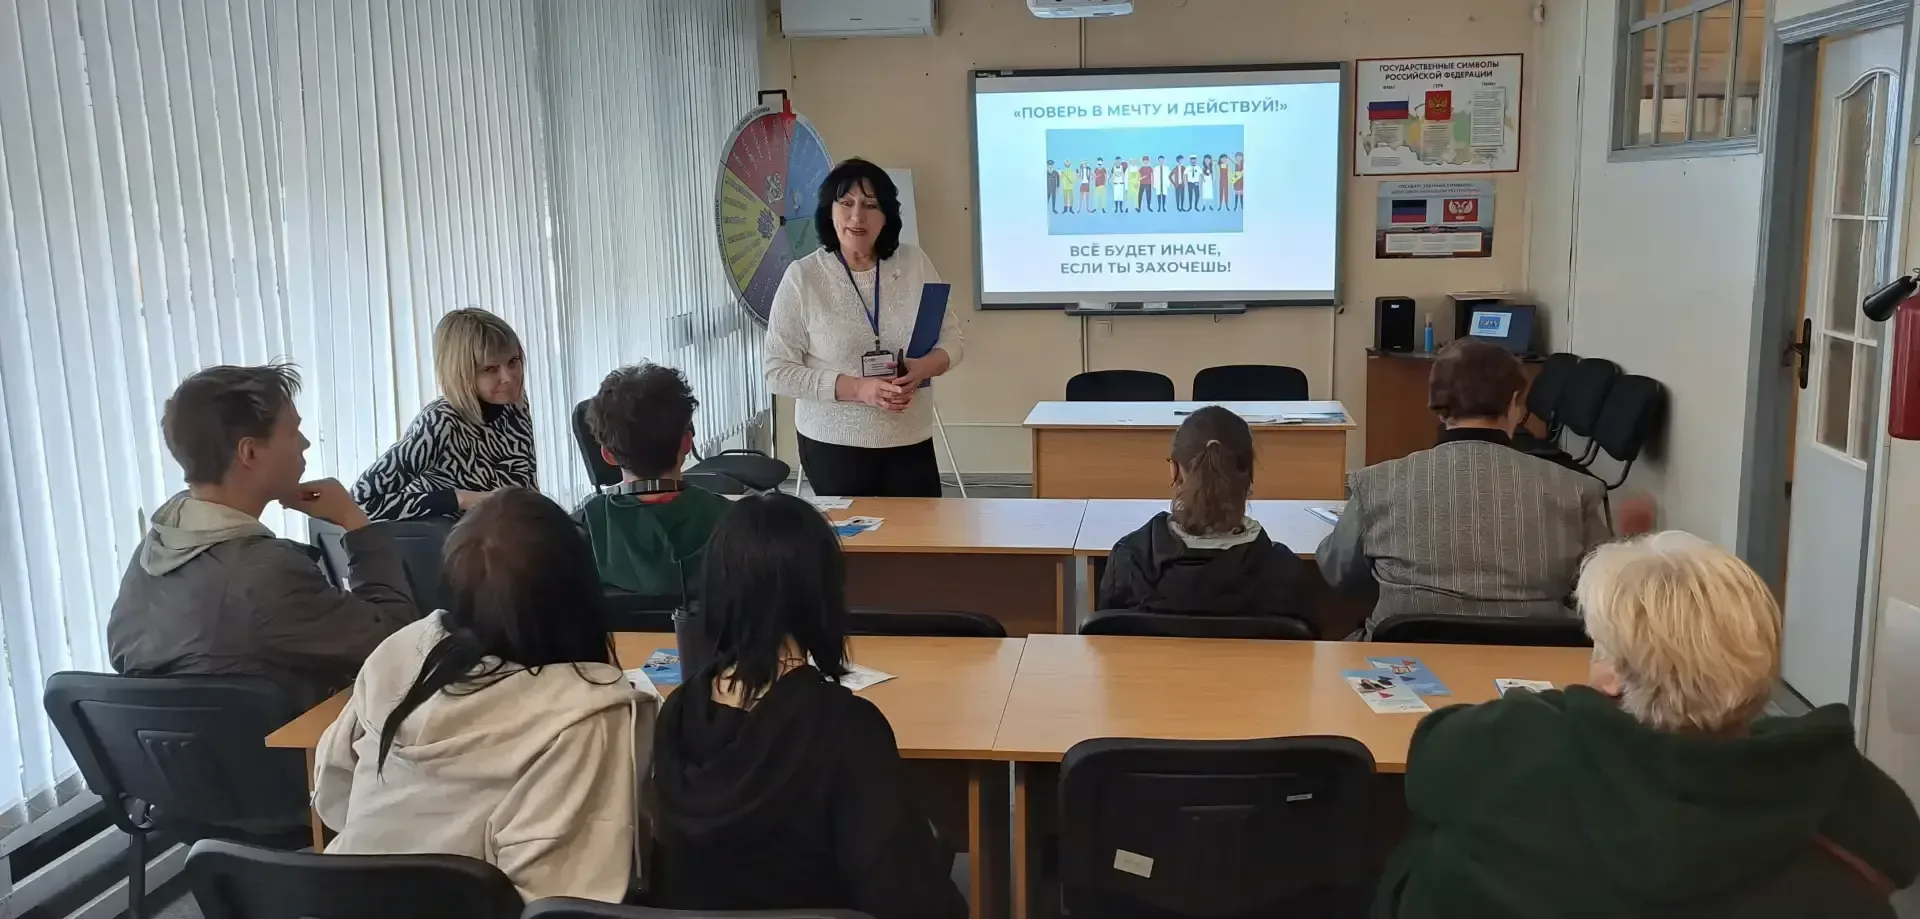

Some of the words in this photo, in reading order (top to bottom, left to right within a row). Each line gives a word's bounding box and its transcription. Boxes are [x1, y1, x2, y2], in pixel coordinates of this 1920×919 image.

[1380, 62, 1455, 72] ГОСУДАРСТВЕННЫЕ
[1456, 60, 1499, 69] СИМВОЛЫ
[1385, 71, 1442, 81] РОССИЙСКОЙ
[1444, 70, 1493, 79] ФЕДЕРАЦИИ
[1013, 106, 1088, 119] «ПОВЕРЬ
[1092, 105, 1102, 117] В
[1107, 103, 1162, 117] МЕЧТУ
[1167, 103, 1178, 115] И
[1183, 97, 1288, 117] ДЕЙСТВУЙ!»
[1070, 242, 1101, 257] ВСЁ
[1105, 244, 1156, 259] БУДЕТ
[1161, 243, 1221, 257] ИНАЧЕ,
[1060, 262, 1103, 274] ЕСЛИ
[1108, 262, 1131, 274] ТЫ
[1136, 261, 1232, 274] ЗАХОЧЕШЬ!
